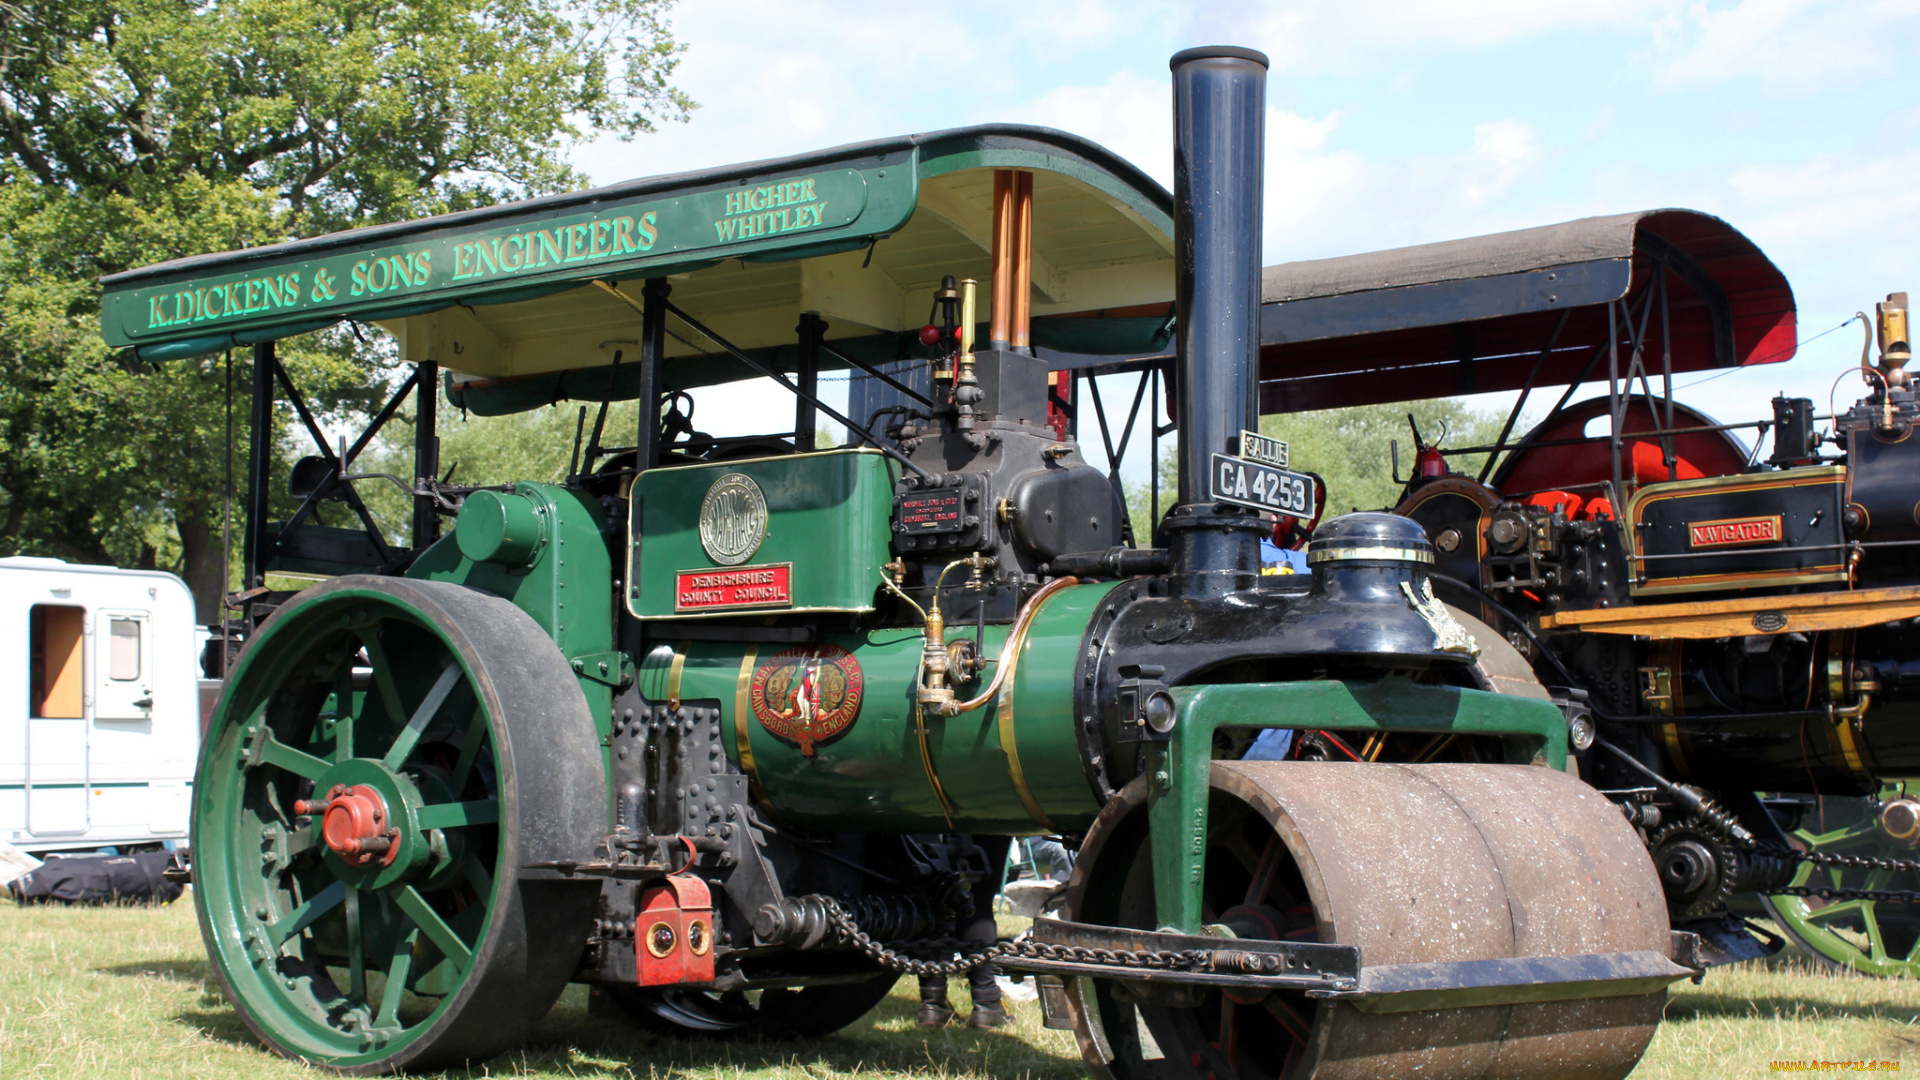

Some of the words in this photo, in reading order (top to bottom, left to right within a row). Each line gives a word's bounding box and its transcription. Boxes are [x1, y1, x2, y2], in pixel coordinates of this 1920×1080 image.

[725, 178, 817, 216] HIGHER
[714, 201, 828, 243] WHITLEY
[148, 271, 300, 329] K.DICKENS
[311, 267, 338, 303] &
[351, 248, 432, 297] SONS
[452, 211, 658, 281] ENGINEERS
[1246, 436, 1285, 464] SALLIE
[1220, 462, 1248, 499] CA
[1252, 470, 1305, 511] 4253
[1693, 521, 1772, 544] NAVIGATOR
[680, 590, 725, 605] COUNTY
[734, 586, 786, 601] COUNCIL
[691, 571, 775, 589] DENBIGHSHIRE
[754, 648, 805, 686] MARSHALL
[827, 646, 851, 665] SONS
[846, 661, 857, 673] &
